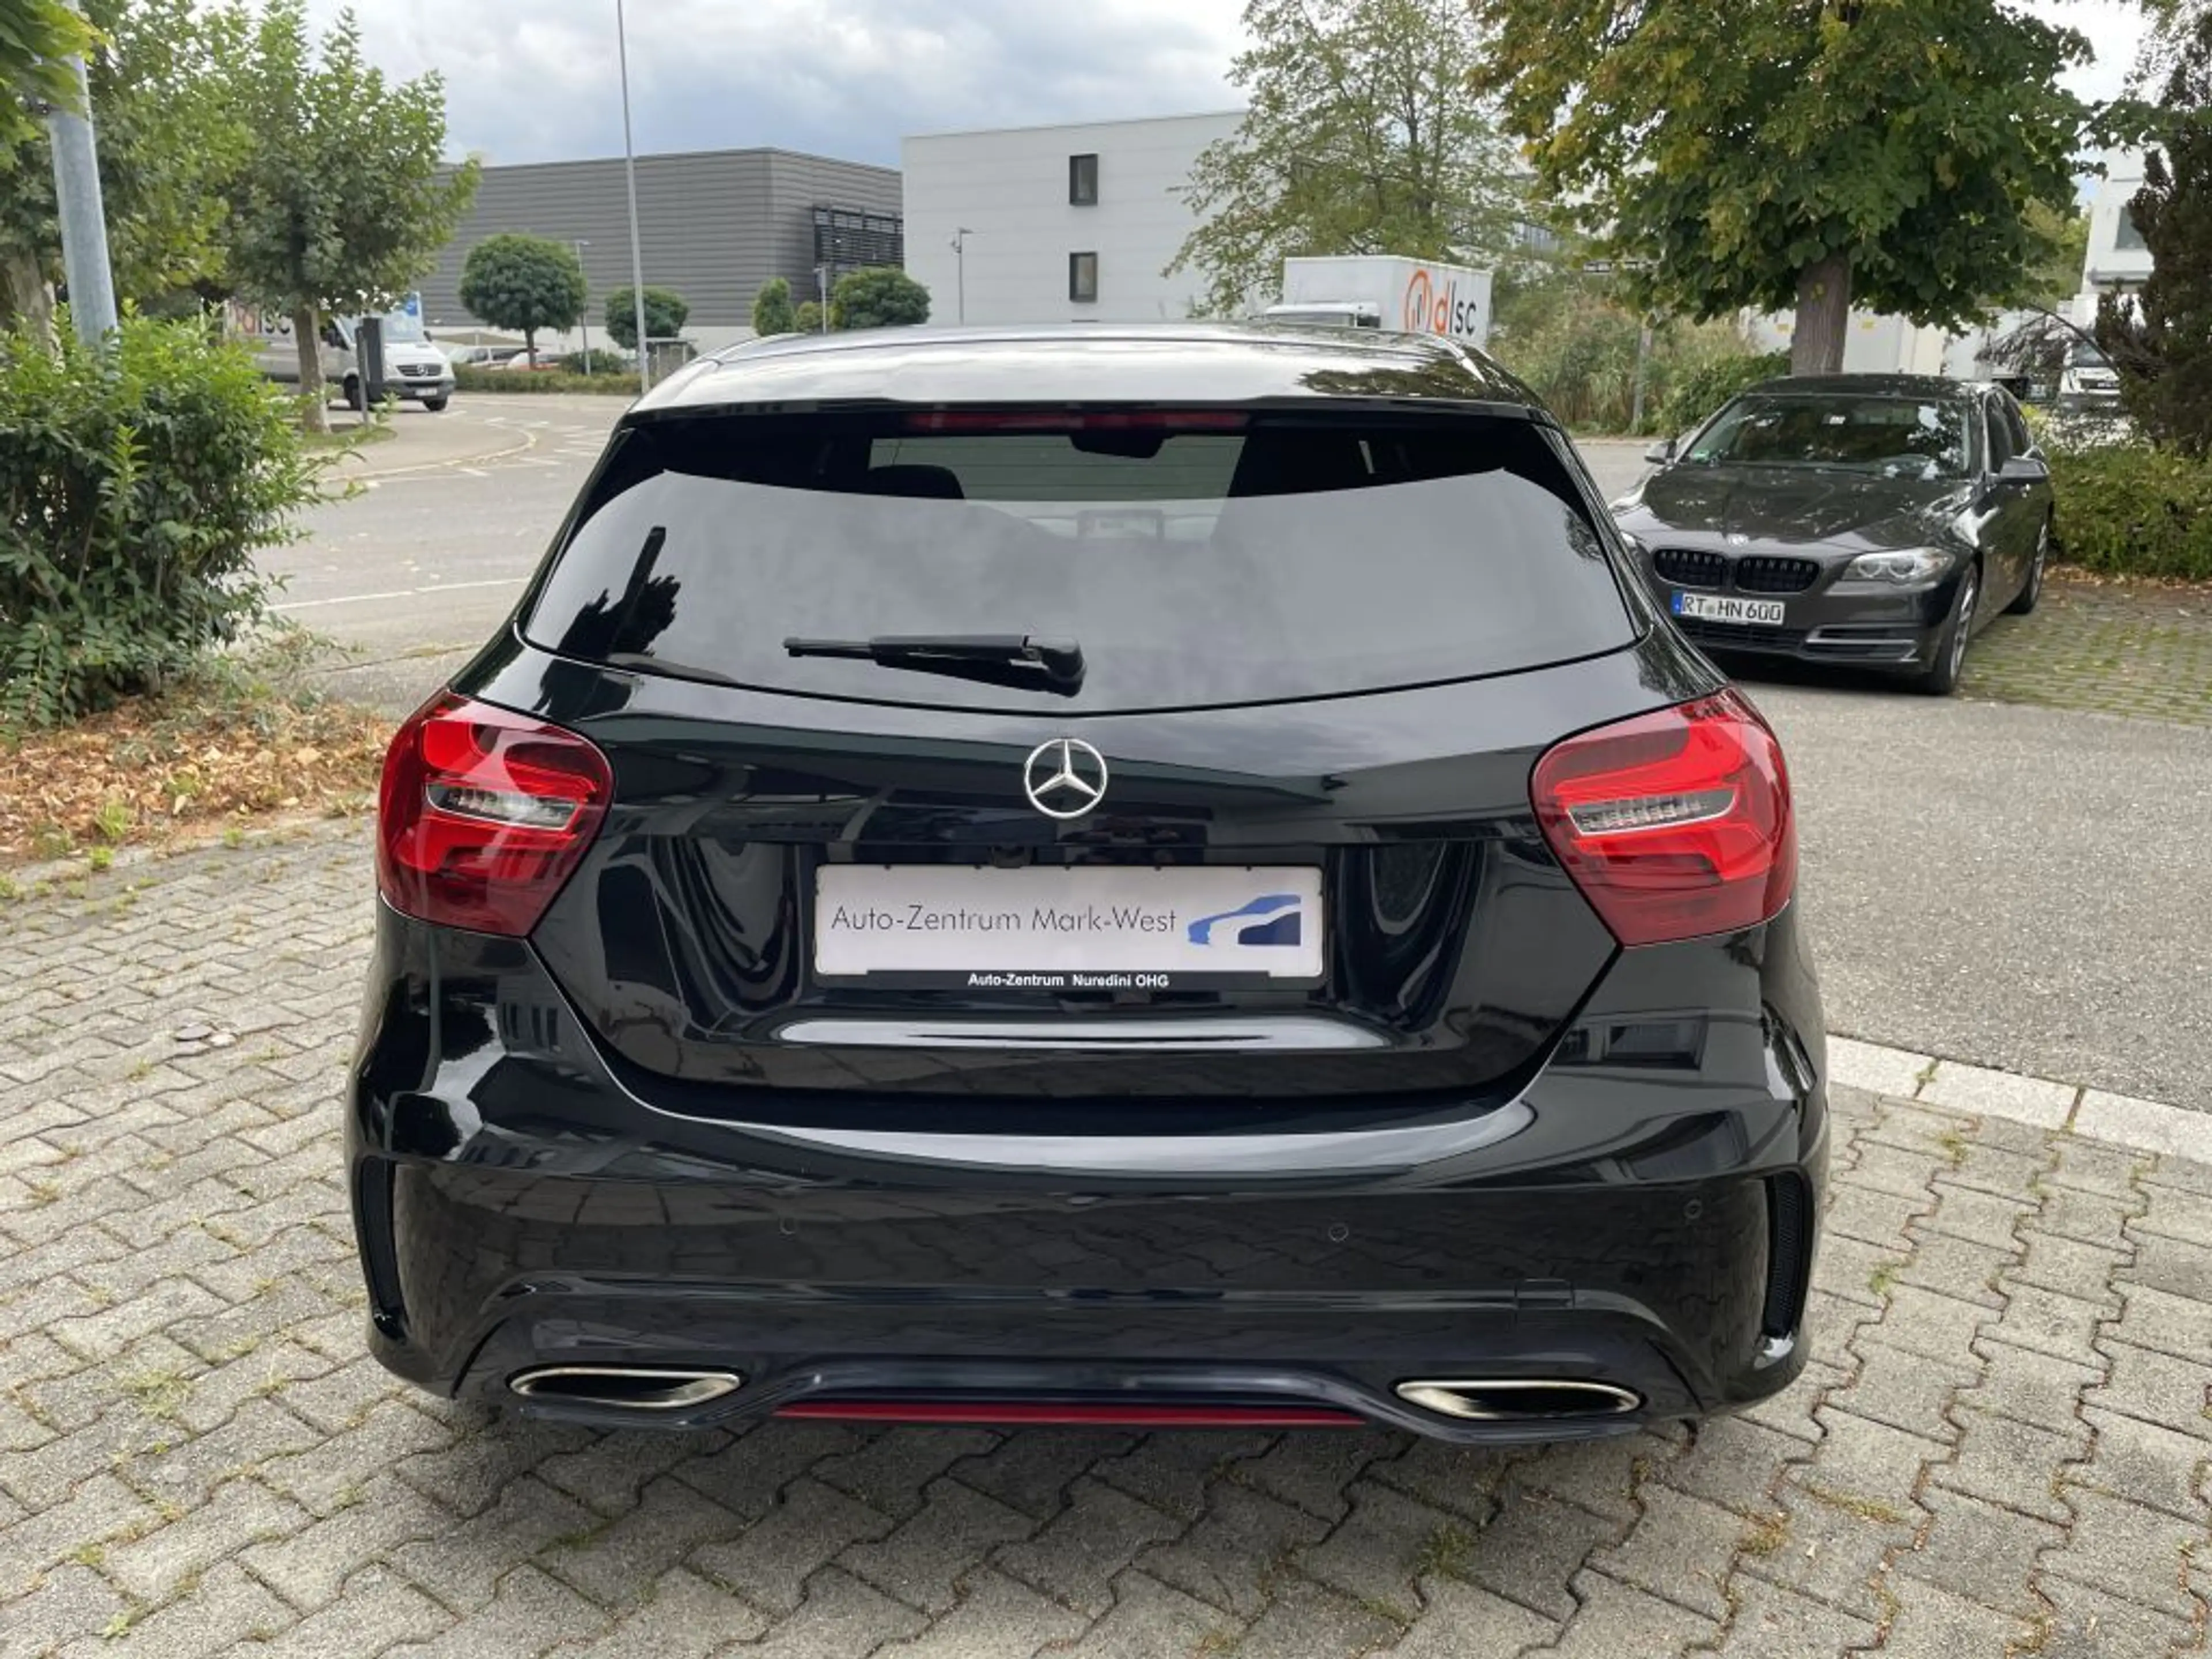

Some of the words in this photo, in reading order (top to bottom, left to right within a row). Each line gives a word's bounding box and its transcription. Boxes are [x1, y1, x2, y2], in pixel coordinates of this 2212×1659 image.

[1684, 596, 1706, 613] RT
[1718, 600, 1743, 618] HN
[1746, 603, 1781, 620] 600
[831, 904, 1021, 931] Auto-Zentrum
[1032, 904, 1176, 932] Mark-West
[968, 973, 1064, 987] Auto-Zentrum
[1073, 974, 1131, 987] Nuredini
[1135, 975, 1169, 987] OHG
